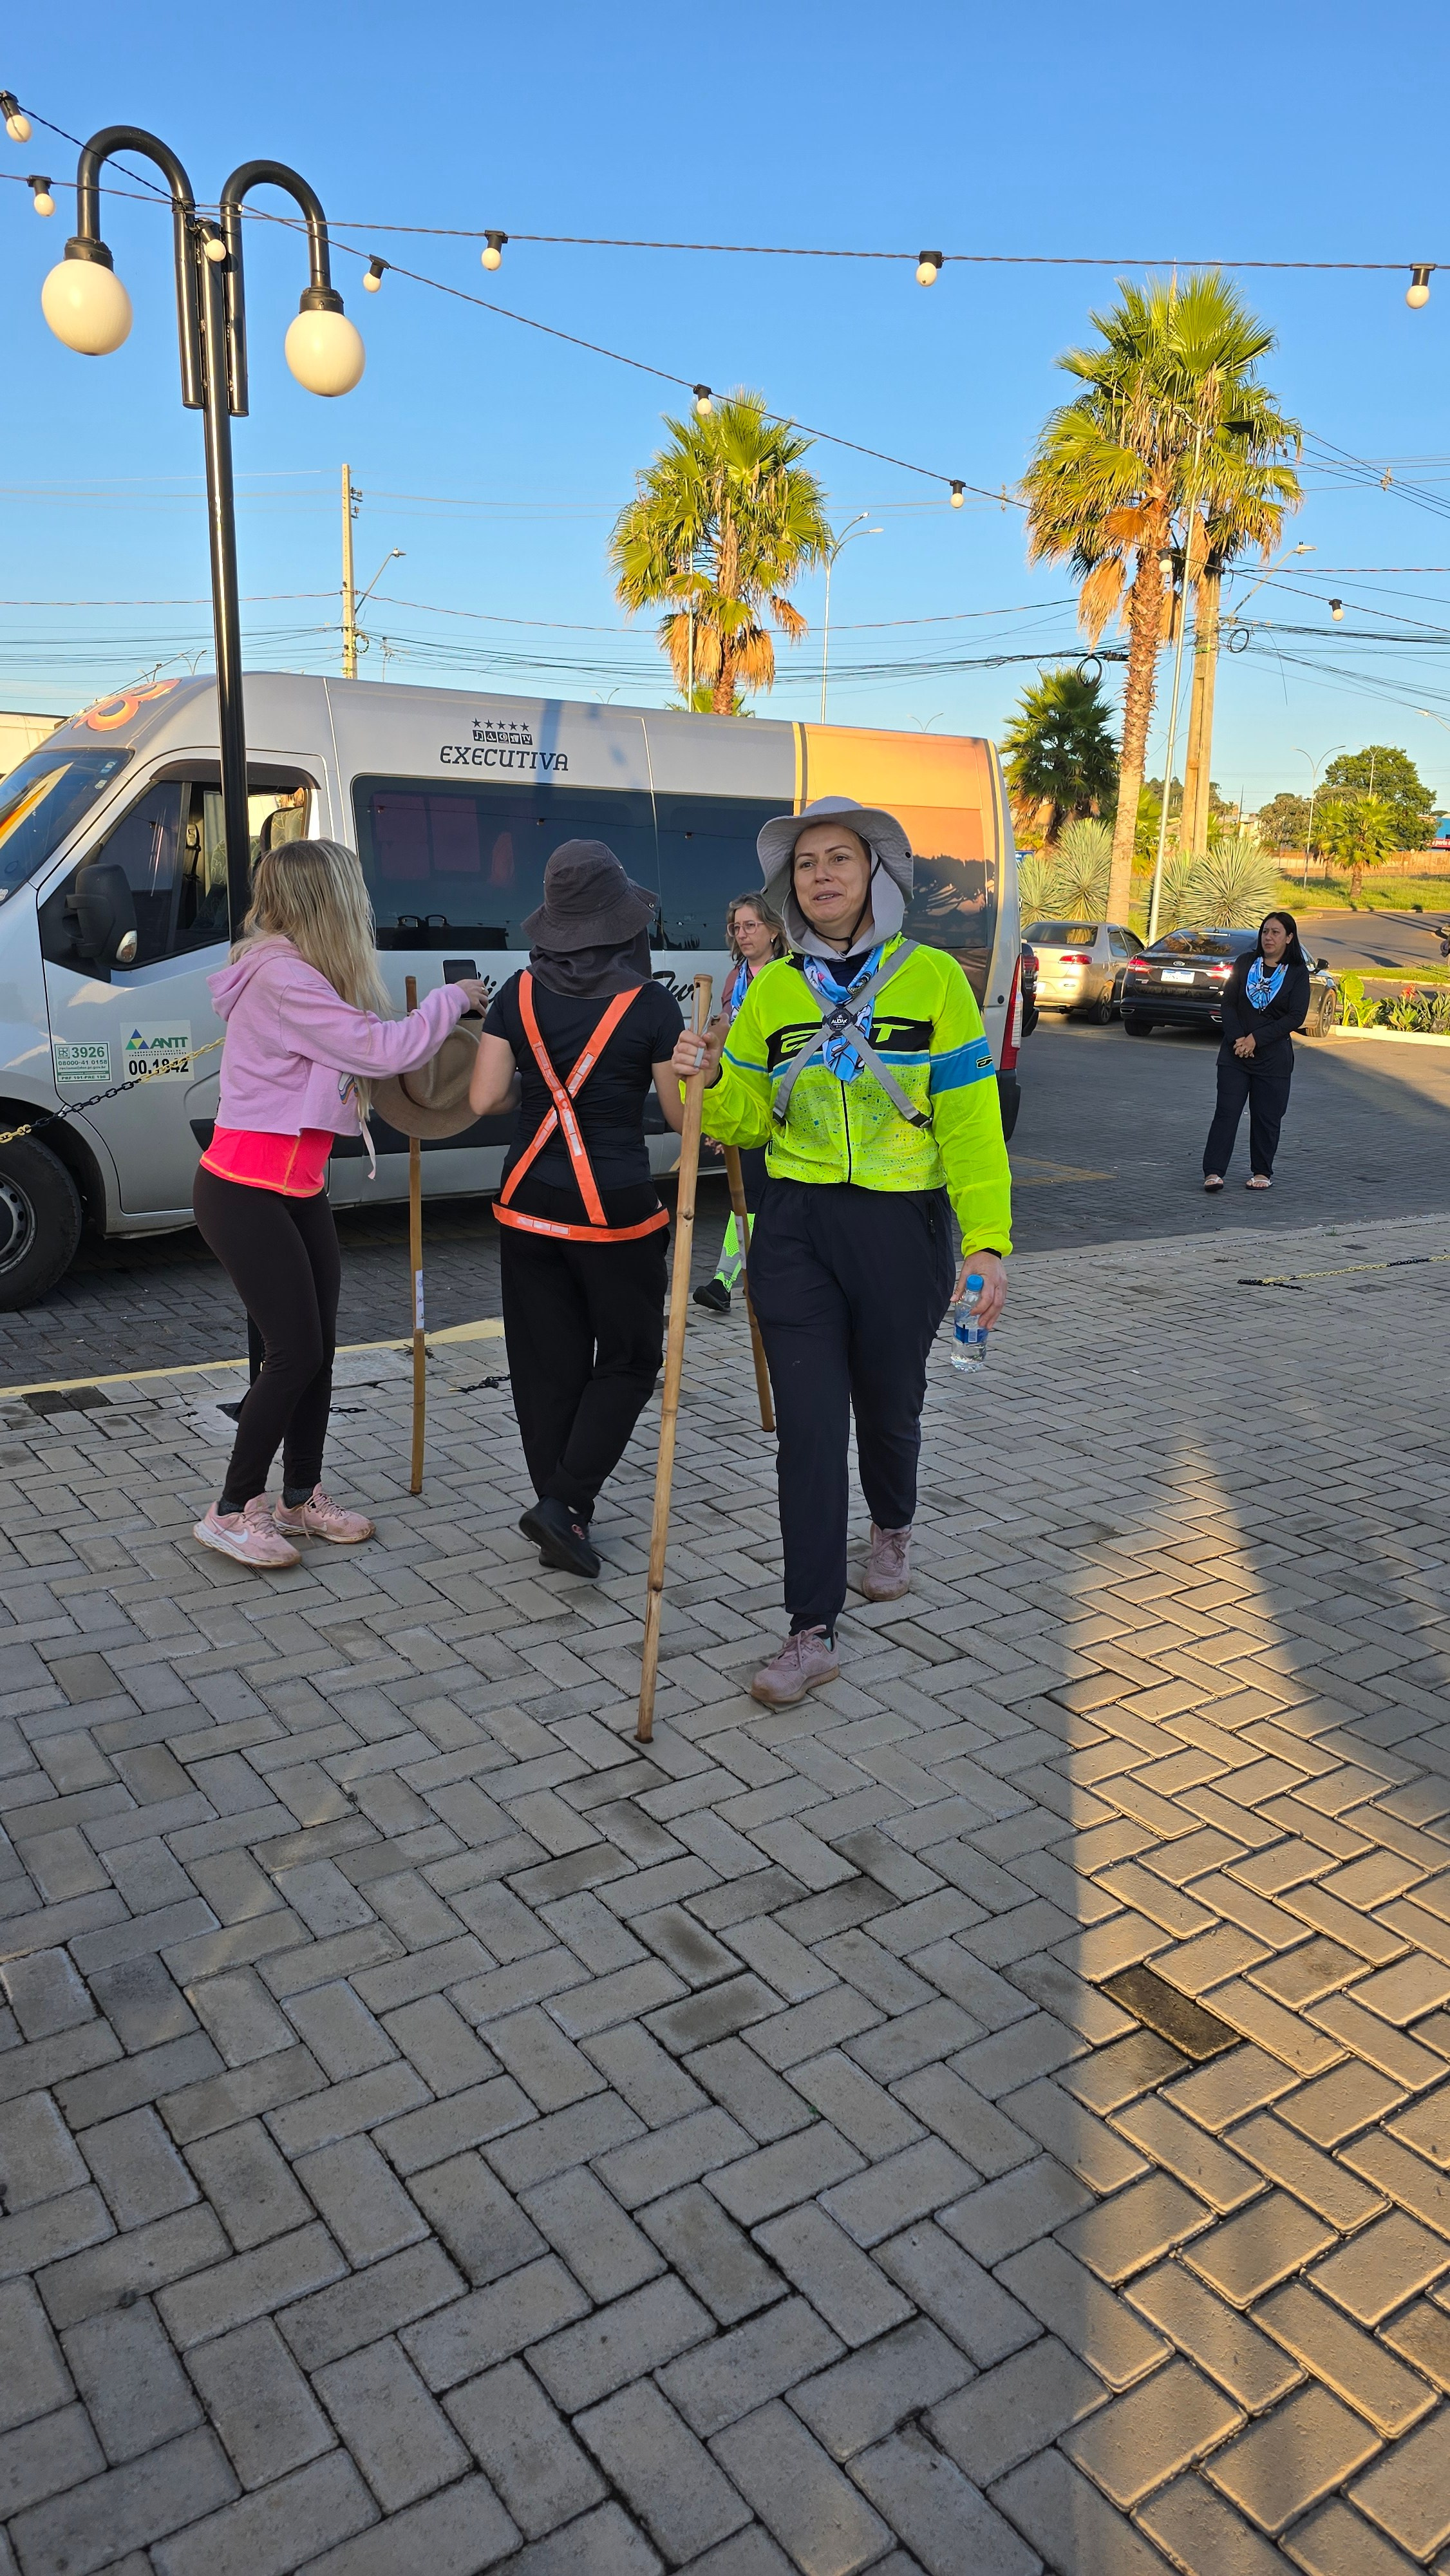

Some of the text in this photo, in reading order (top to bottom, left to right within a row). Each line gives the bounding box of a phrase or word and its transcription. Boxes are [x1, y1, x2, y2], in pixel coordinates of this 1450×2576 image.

[440, 745, 569, 772] EXECUTIVA
[149, 1036, 189, 1049] ANTT
[71, 1046, 105, 1058] 3926
